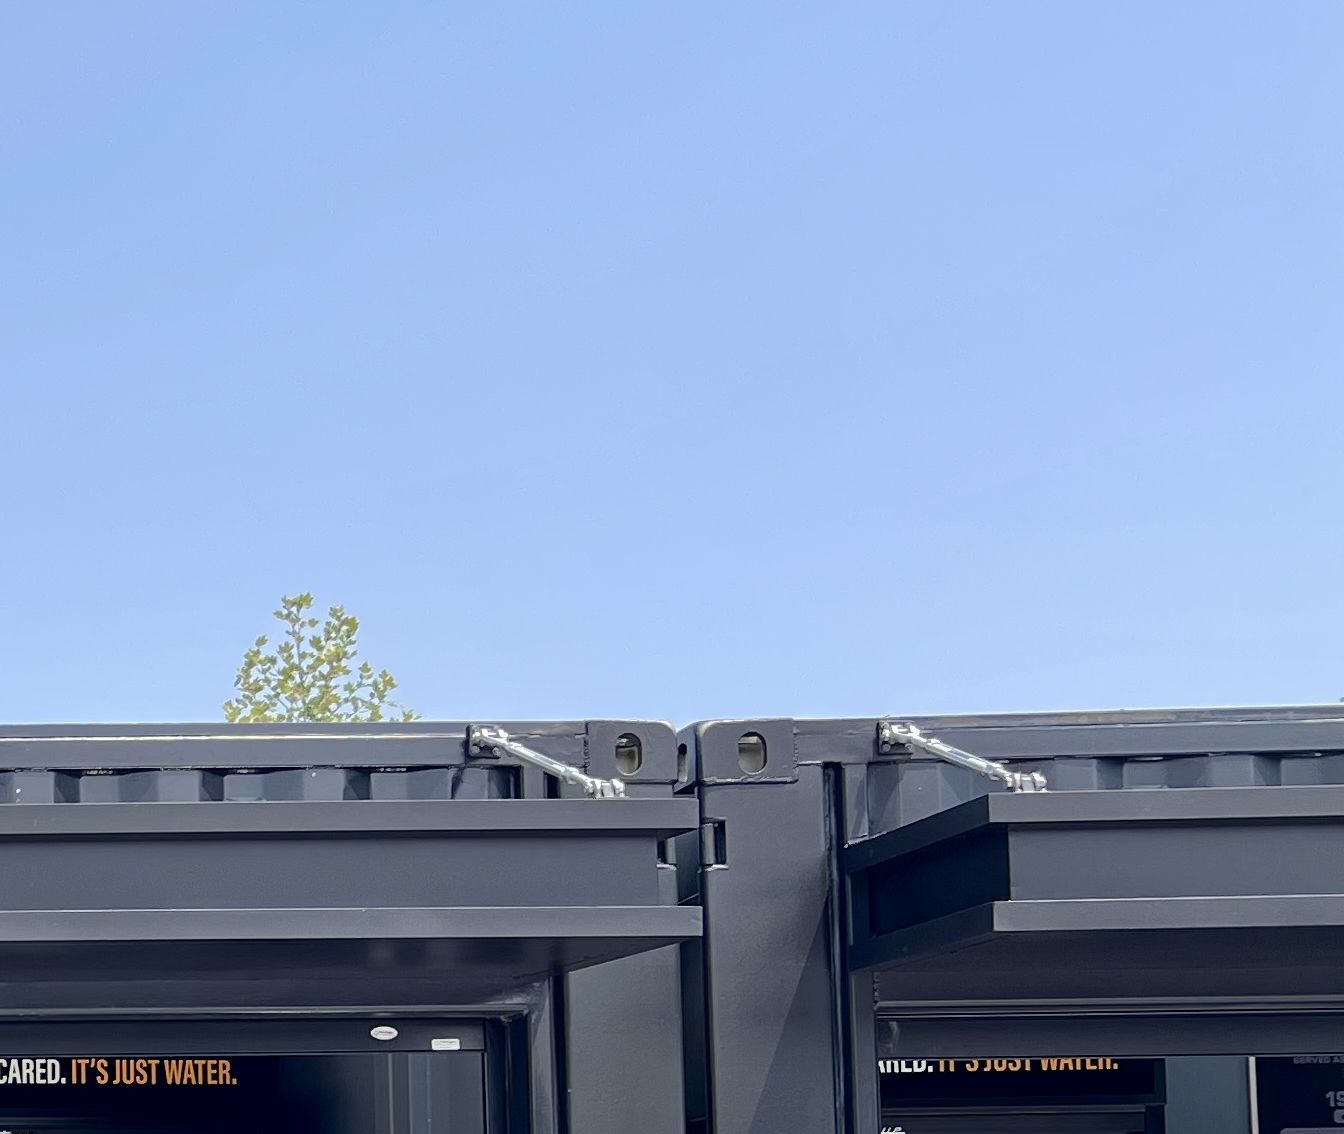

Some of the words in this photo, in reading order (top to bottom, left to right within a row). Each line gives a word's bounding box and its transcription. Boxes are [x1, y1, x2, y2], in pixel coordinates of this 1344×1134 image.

[71, 1059, 110, 1085] IT'S
[113, 1059, 160, 1085] JUST
[164, 1059, 238, 1085] WATER.
